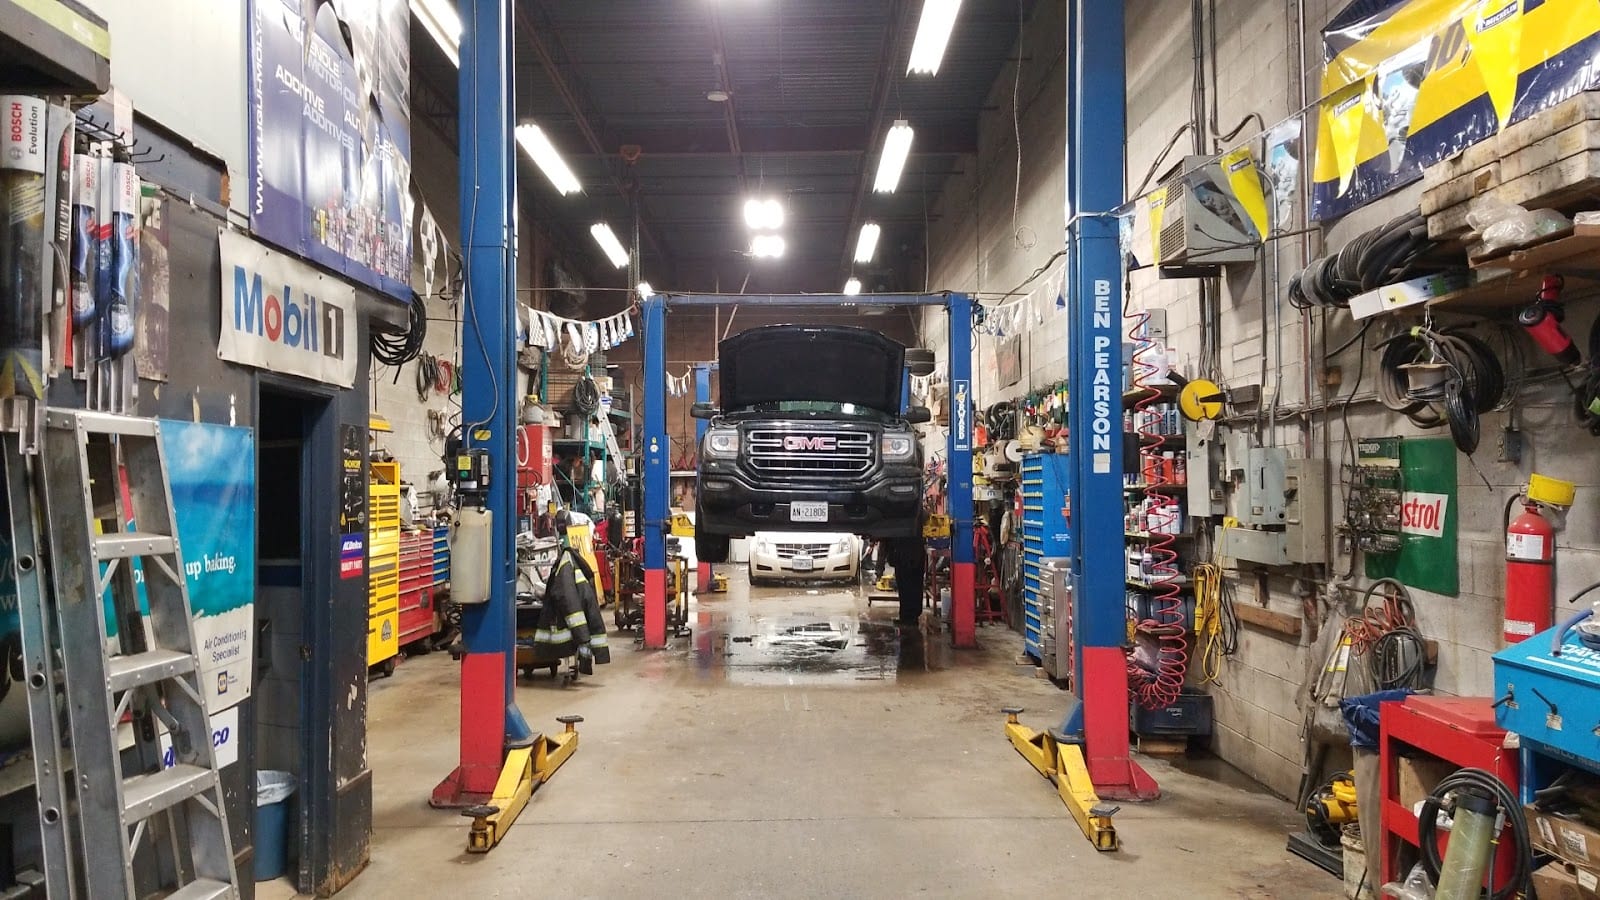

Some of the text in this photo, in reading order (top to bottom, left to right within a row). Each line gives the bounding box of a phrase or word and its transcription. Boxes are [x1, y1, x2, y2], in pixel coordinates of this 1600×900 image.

[275, 64, 325, 114] ADDITIVE
[11, 102, 22, 142] BOSCH
[29, 106, 38, 155] Evolution
[302, 102, 355, 152] ADDITIVES
[233, 265, 318, 353] Mobil
[1092, 279, 1111, 451] BEN PEARSON
[783, 436, 837, 451] GMC
[1402, 498, 1441, 531] strol
[186, 554, 237, 581] up baking.
[203, 629, 247, 651] Air Conditioning
[212, 646, 240, 663] Specialist
